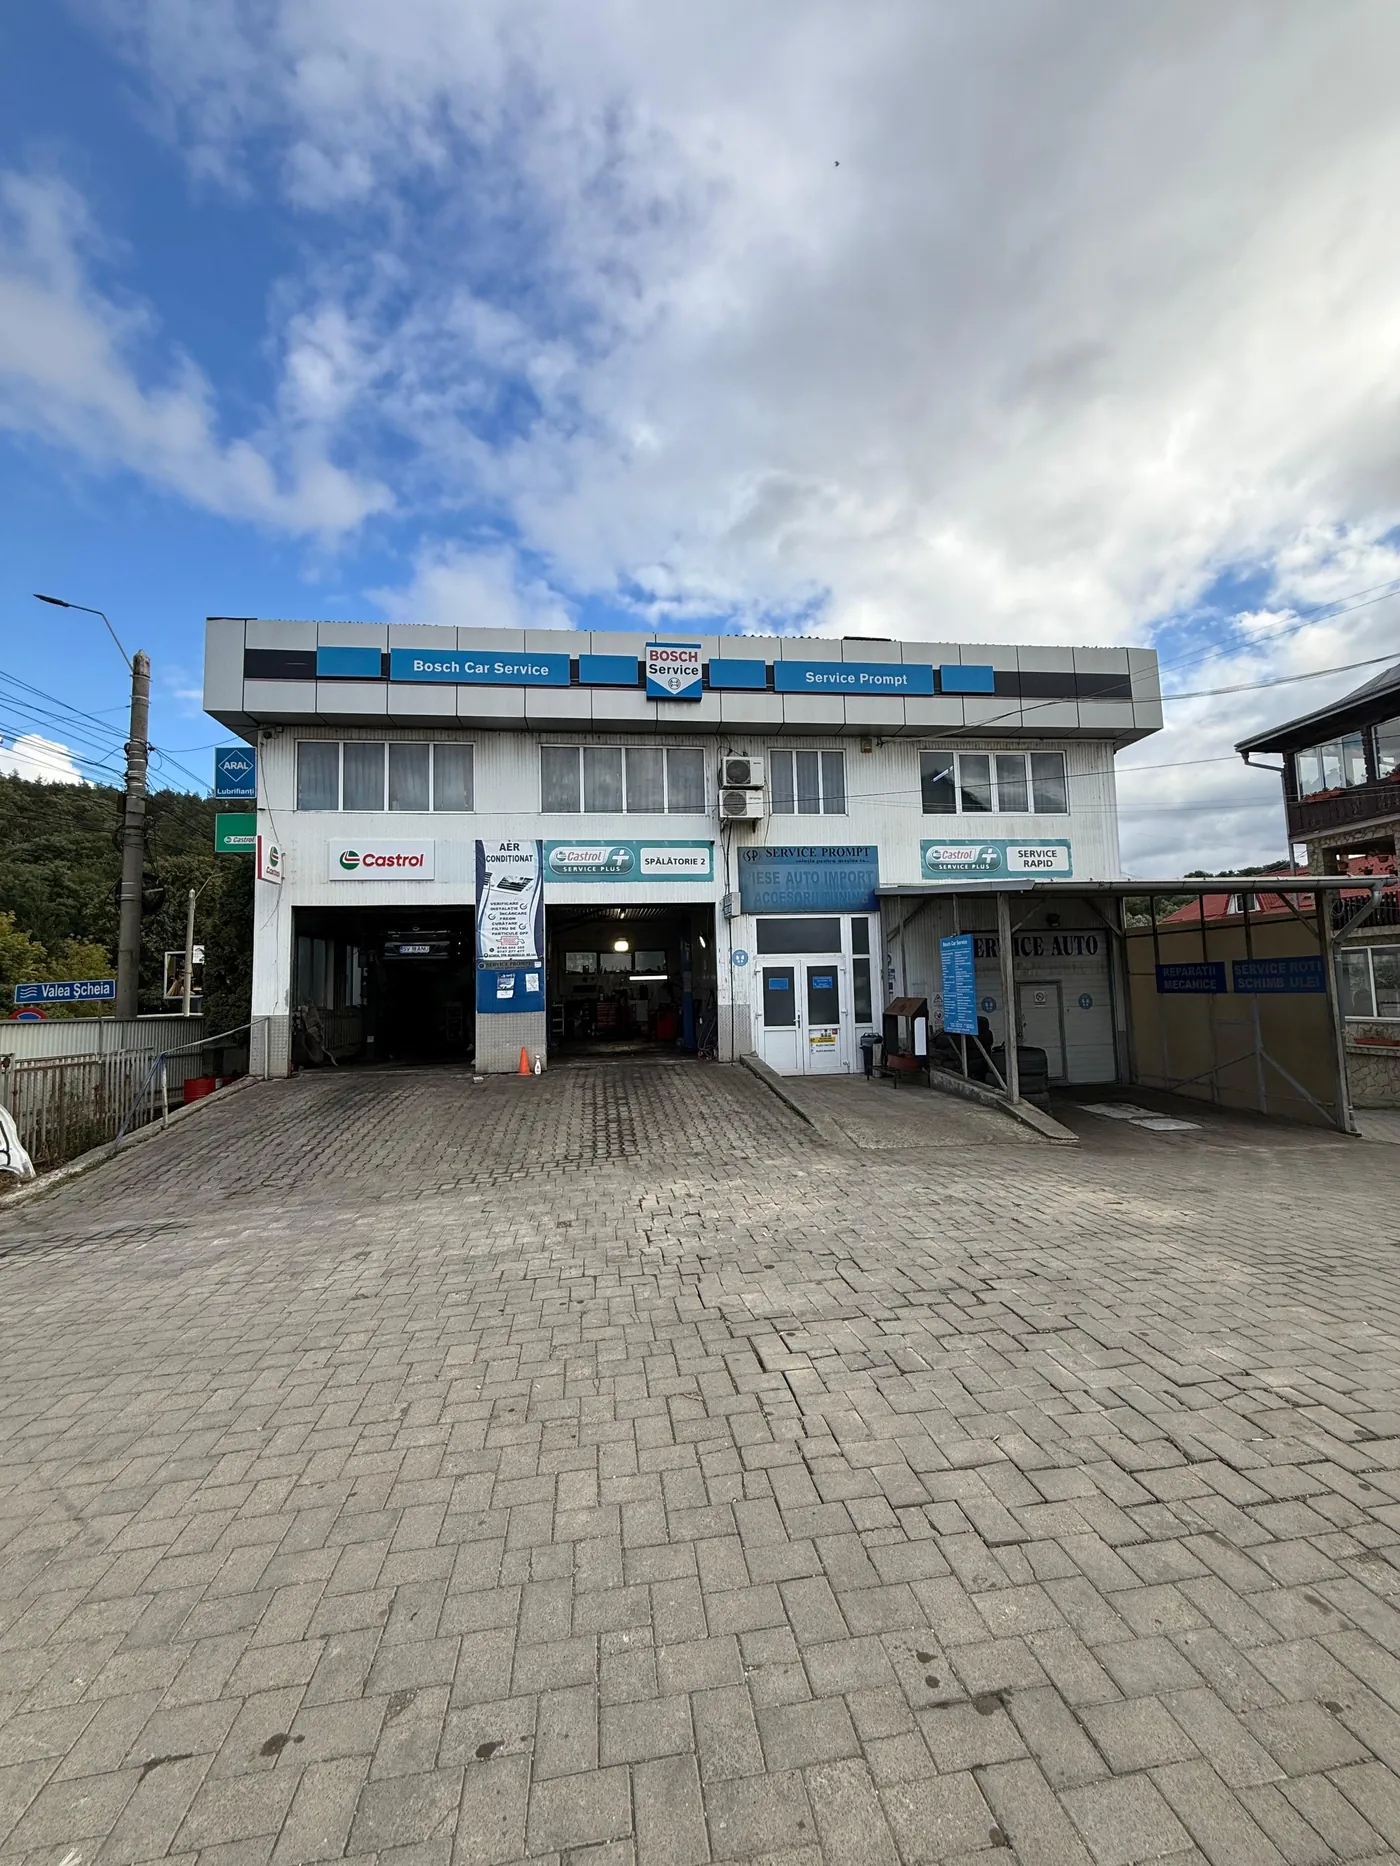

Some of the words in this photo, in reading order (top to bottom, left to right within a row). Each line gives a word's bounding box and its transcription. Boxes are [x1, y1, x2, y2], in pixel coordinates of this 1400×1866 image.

[650, 650, 698, 662] BOSCH
[413, 660, 460, 673] Bosch
[464, 662, 490, 674] Car
[494, 662, 549, 676] Service
[649, 664, 699, 676] Service
[805, 672, 856, 684] Service
[860, 673, 908, 687] Prompt
[223, 762, 249, 770] ARAL
[499, 843, 520, 851] AER
[766, 847, 817, 858] SERVICE
[822, 847, 870, 857] PROMPT
[567, 852, 602, 862] Castrol
[942, 850, 973, 860] Castrol
[1018, 850, 1058, 858] SERVICE
[363, 854, 425, 867] Castrol
[644, 856, 698, 866] SPĂLĂTORIE
[700, 858, 705, 866] 2
[1024, 859, 1053, 868] RAPID
[786, 871, 820, 885] AUTO
[825, 871, 873, 884] IMPORT
[1051, 935, 1098, 955] AUTO
[1163, 966, 1216, 977] REPARATII
[1234, 963, 1286, 975] SERVICE
[1289, 960, 1322, 973] ROTI
[1164, 979, 1217, 990] MECANICE
[1238, 977, 1284, 989] SCHIMB
[1289, 976, 1320, 988] ULEI
[41, 984, 71, 998] Valea
